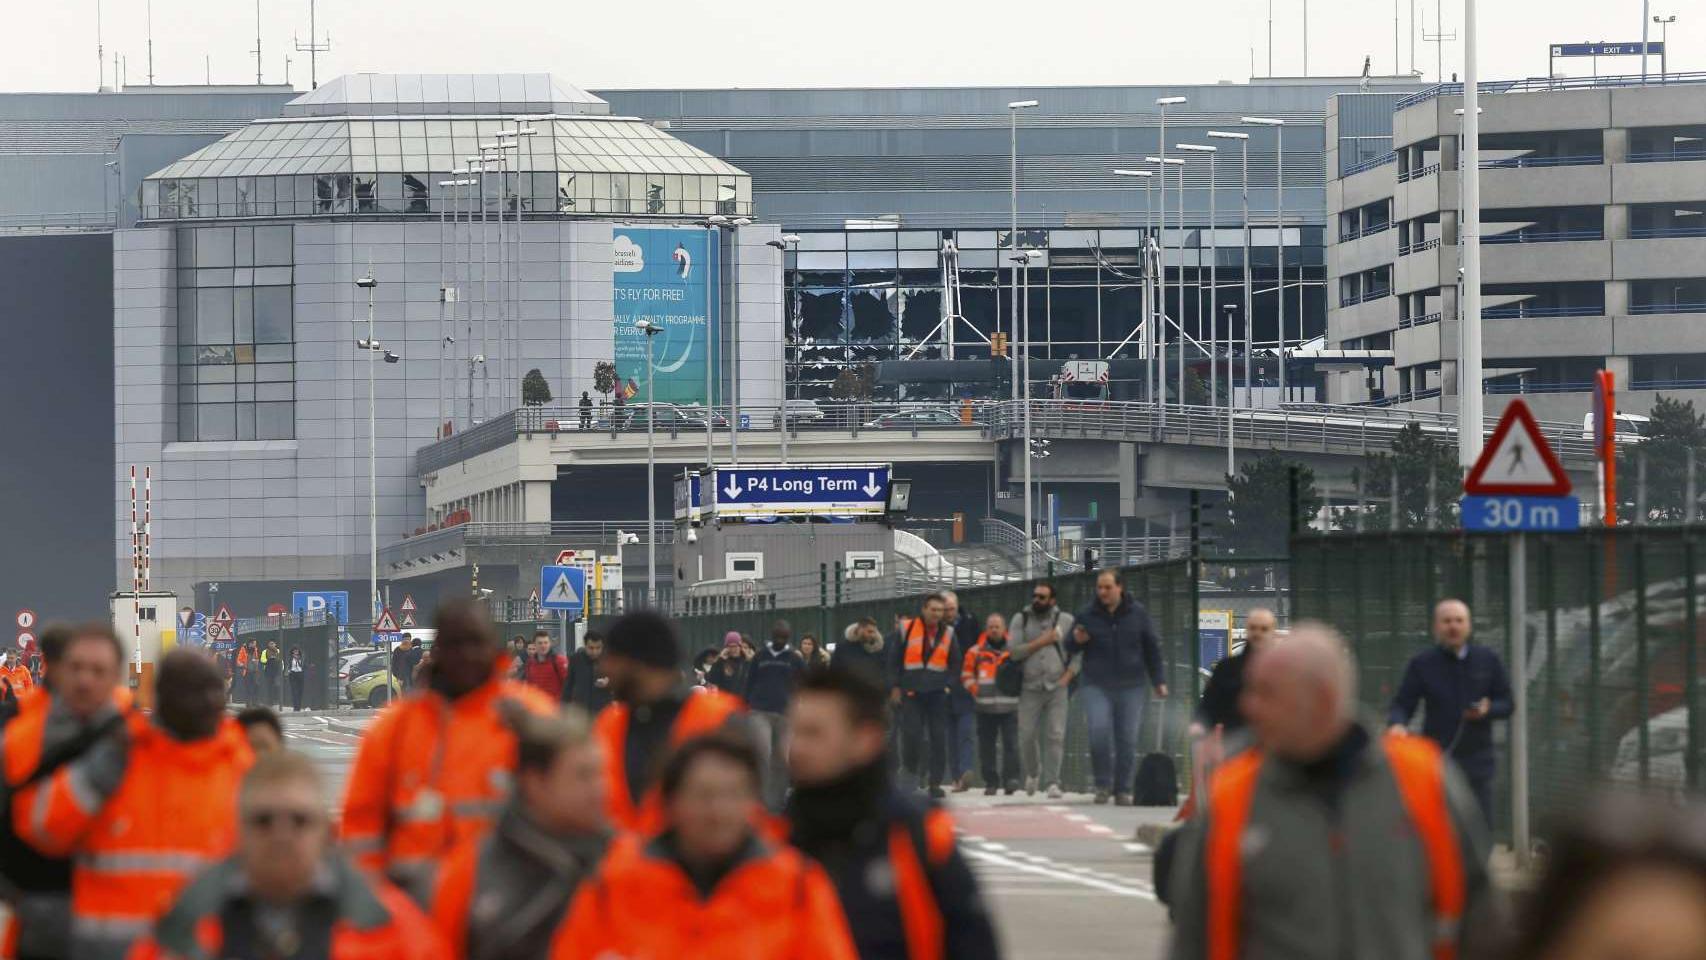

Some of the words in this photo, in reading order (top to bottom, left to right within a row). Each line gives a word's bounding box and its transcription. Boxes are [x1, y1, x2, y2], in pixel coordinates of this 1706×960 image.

[628, 288, 641, 300] FLY
[644, 288, 660, 300] FOR
[662, 289, 684, 301] FREE!
[665, 315, 706, 325] PROGRAMME
[747, 477, 768, 492] P4
[773, 478, 813, 495] Long
[817, 476, 857, 491] Term
[1483, 498, 1523, 528] 30
[1529, 504, 1559, 527] m
[307, 595, 326, 617] P
[377, 634, 388, 642] 30
